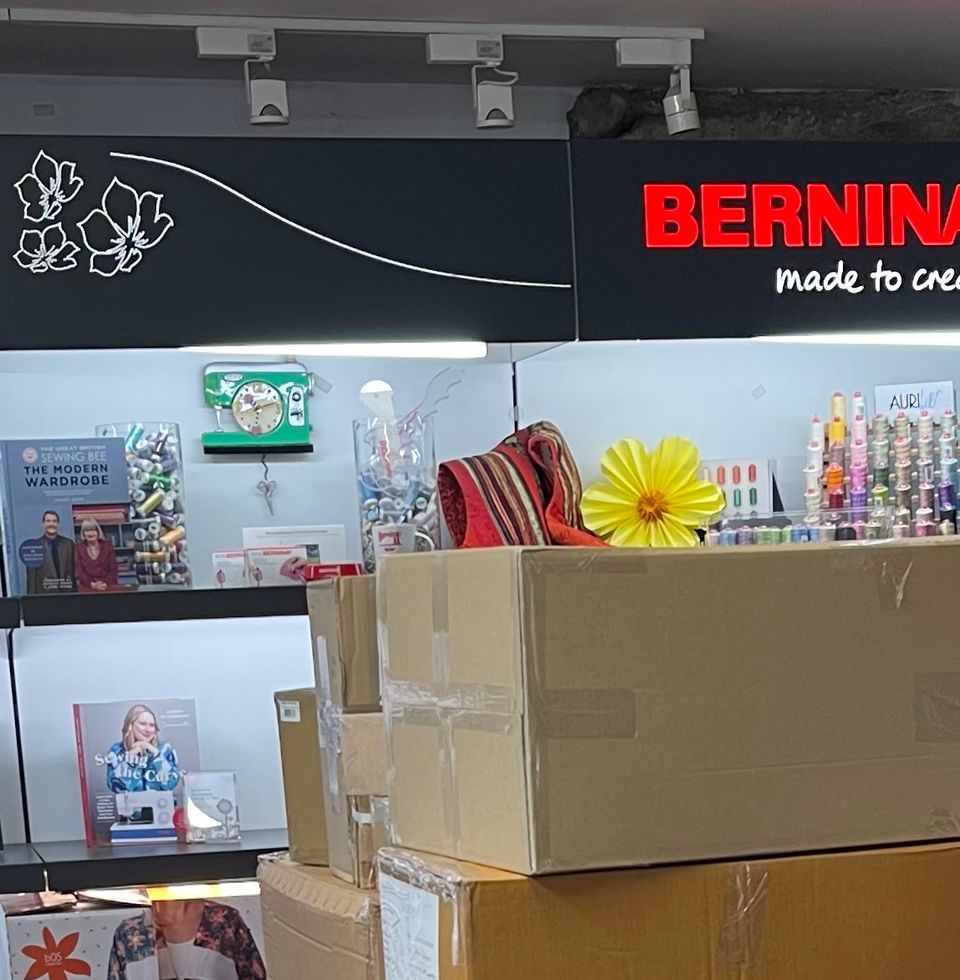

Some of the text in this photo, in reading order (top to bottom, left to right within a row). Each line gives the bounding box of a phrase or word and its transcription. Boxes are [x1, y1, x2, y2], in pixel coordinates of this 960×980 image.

[776, 259, 864, 294] made
[870, 259, 902, 292] to
[41, 451, 107, 463] SEWING BEE
[24, 464, 108, 475] THE MODERN
[25, 475, 109, 487] WARDROBE
[94, 752, 148, 768] Sewing
[114, 766, 141, 779] the
